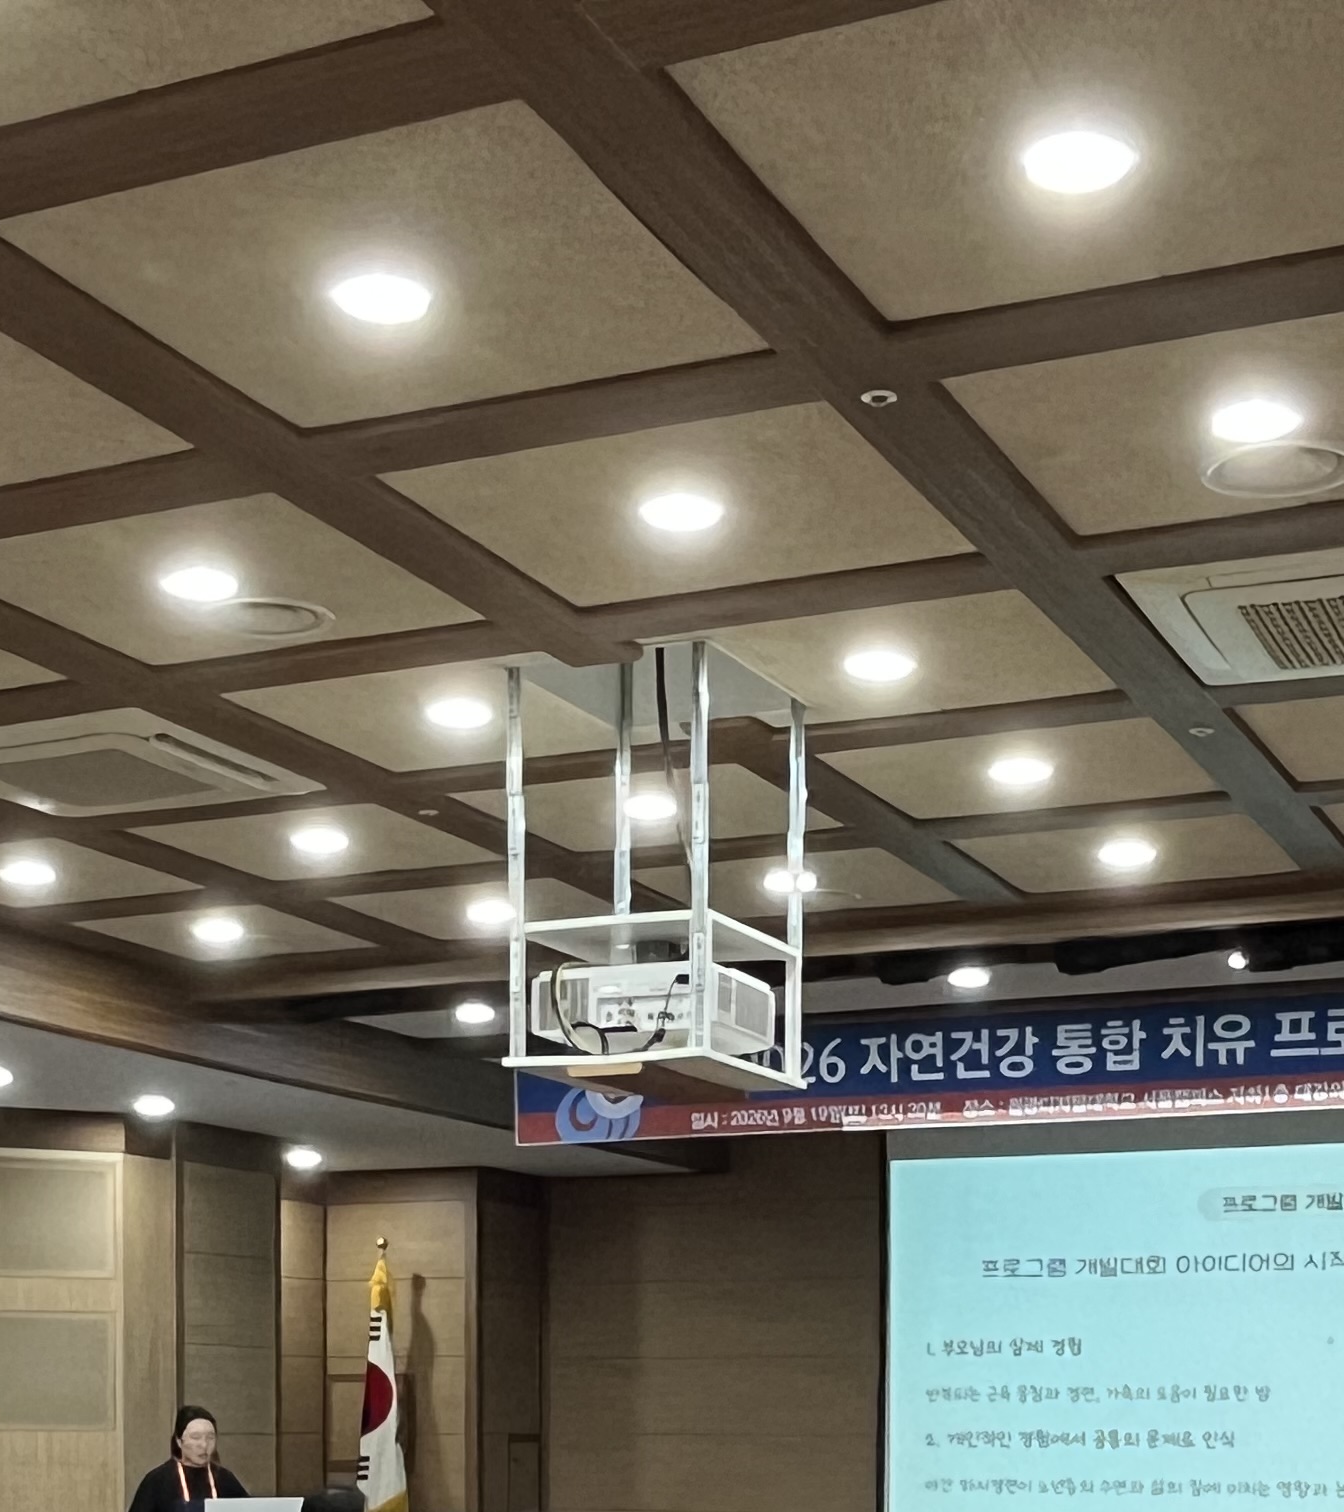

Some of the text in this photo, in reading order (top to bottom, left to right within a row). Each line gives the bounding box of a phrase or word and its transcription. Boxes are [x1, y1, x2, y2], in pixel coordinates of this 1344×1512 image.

[750, 1037, 846, 1084] 026
[859, 1026, 1040, 1083] 자연건강
[1051, 1018, 1147, 1075] 통합
[1160, 1014, 1256, 1068] 치유
[1222, 1194, 1298, 1213] 프로그램
[1306, 1191, 1344, 1211] 개발
[981, 1257, 1067, 1278] 프로그램
[1074, 1255, 1167, 1278] 개발대회
[1175, 1252, 1295, 1274] 아이디어의
[941, 1338, 1003, 1358] 부모님의
[1009, 1337, 1044, 1357] 실제
[1051, 1336, 1082, 1357] 경험
